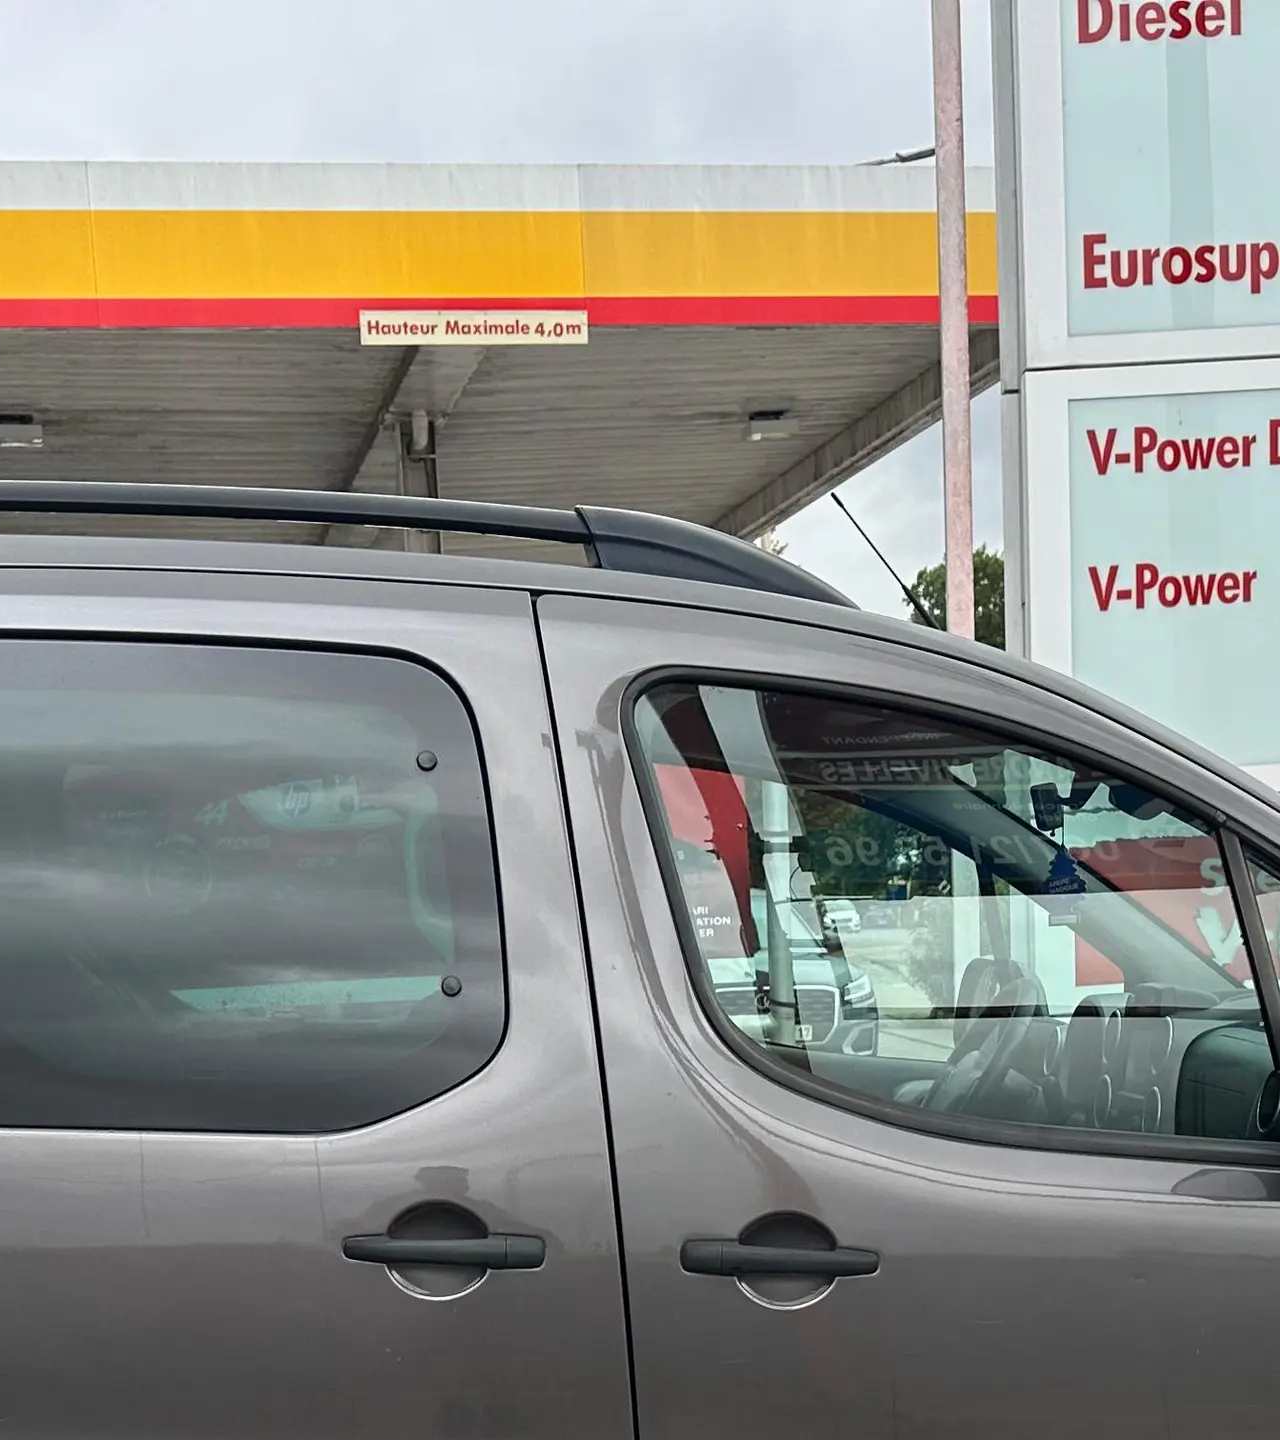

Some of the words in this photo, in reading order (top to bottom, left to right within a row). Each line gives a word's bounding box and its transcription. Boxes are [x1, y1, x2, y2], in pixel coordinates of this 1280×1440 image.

[1077, 0, 1243, 44] Diesel
[367, 320, 438, 336] Hauteur
[445, 320, 530, 336] Maximale
[1086, 426, 1257, 476] V-Power
[1089, 563, 1258, 613] V-Power
[282, 782, 313, 822] hp
